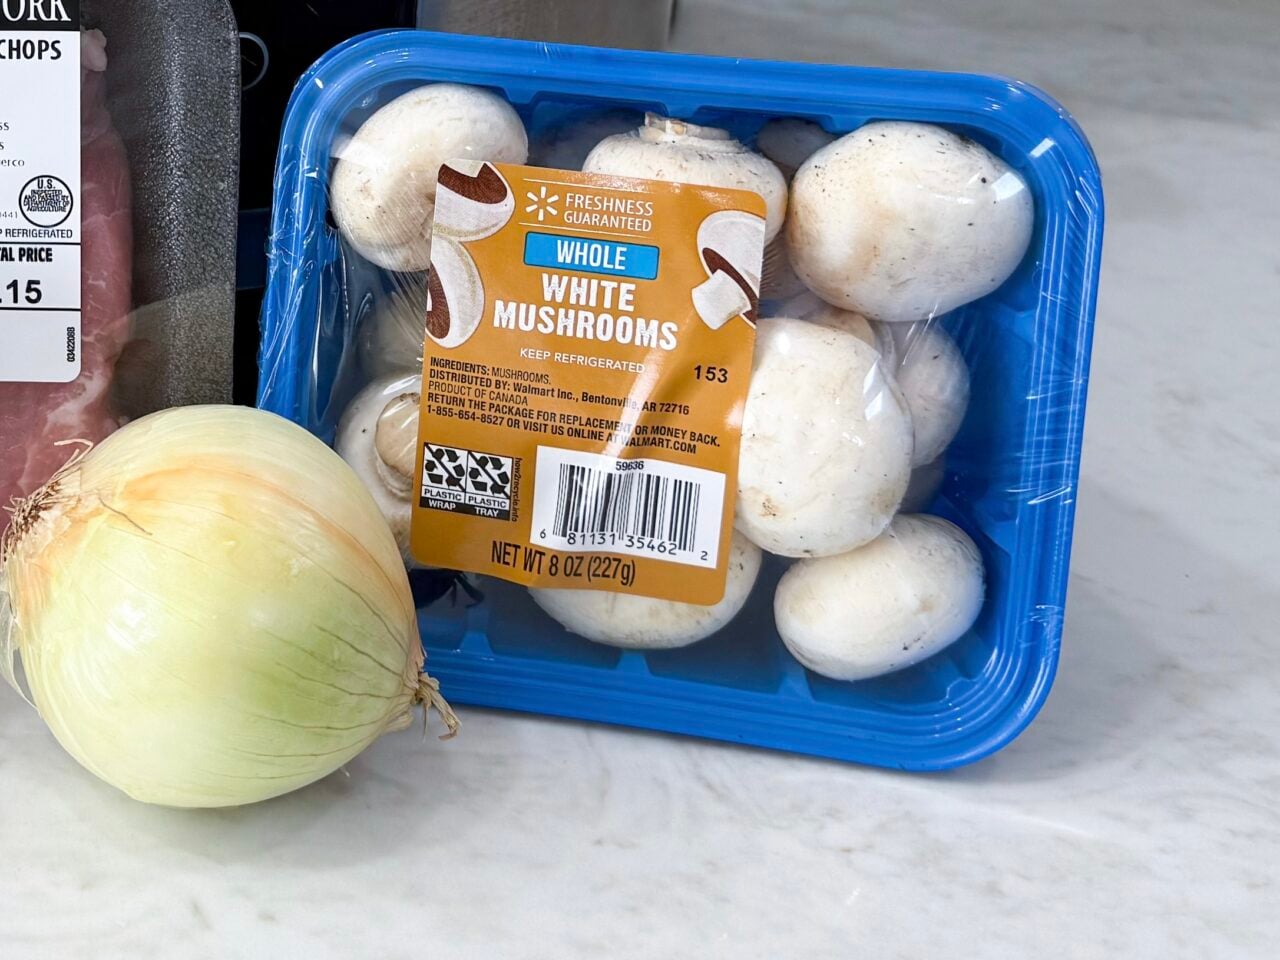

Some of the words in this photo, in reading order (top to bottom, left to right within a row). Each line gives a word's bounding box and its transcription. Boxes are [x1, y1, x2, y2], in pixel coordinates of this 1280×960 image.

[565, 192, 654, 216] FRESHNESS
[5, 228, 73, 239] REFRIGERATED
[563, 210, 652, 232] GUARANTEED
[19, 247, 53, 262] PRICE
[556, 240, 627, 271] WHOLE
[541, 273, 637, 312] WHITE
[492, 299, 679, 350] MUSHROOMS
[430, 356, 490, 376] INGREDIENTS:
[491, 366, 551, 385] MUSHROOMS.
[519, 348, 552, 363] KEEP
[553, 352, 646, 373] REFRIGERATED
[693, 365, 729, 384] 153
[428, 380, 473, 397] PRODUCT
[474, 388, 487, 399] OF
[488, 390, 528, 406] CANADA
[429, 368, 492, 388] DISTRIBUTED
[494, 379, 511, 391] BY:
[513, 382, 555, 398] Walmart
[557, 388, 579, 403] Inc.,
[641, 401, 657, 412] AR
[659, 402, 690, 415] 72716
[427, 392, 466, 408] RETURN
[468, 398, 486, 411] THE
[488, 402, 534, 420] PACKAGE
[536, 410, 557, 423] FOR
[559, 413, 632, 434] REPLACEMENT
[635, 425, 648, 436] OR
[650, 425, 688, 439] MONEY
[689, 431, 721, 448] BACK.
[427, 404, 506, 426] 1-855-654-8527
[506, 417, 520, 429] OR
[522, 420, 549, 434] VISIT
[551, 424, 565, 436] US
[566, 426, 605, 442] ONLINE
[606, 431, 618, 444] AT
[621, 434, 697, 455] WALMART.COM
[615, 460, 645, 473] 59636
[424, 488, 462, 502] PLASTIC
[468, 495, 507, 509] PLASTIC
[428, 499, 456, 511] WRAP
[474, 506, 500, 518] TRAY
[539, 528, 547, 539] 6
[567, 532, 616, 546] 81131
[625, 534, 678, 556] 35462
[700, 550, 709, 561] 2
[491, 540, 521, 569] NET
[523, 549, 546, 575] WT
[548, 554, 559, 577] 8
[563, 555, 585, 577] OZ
[587, 556, 637, 587] (227g)
